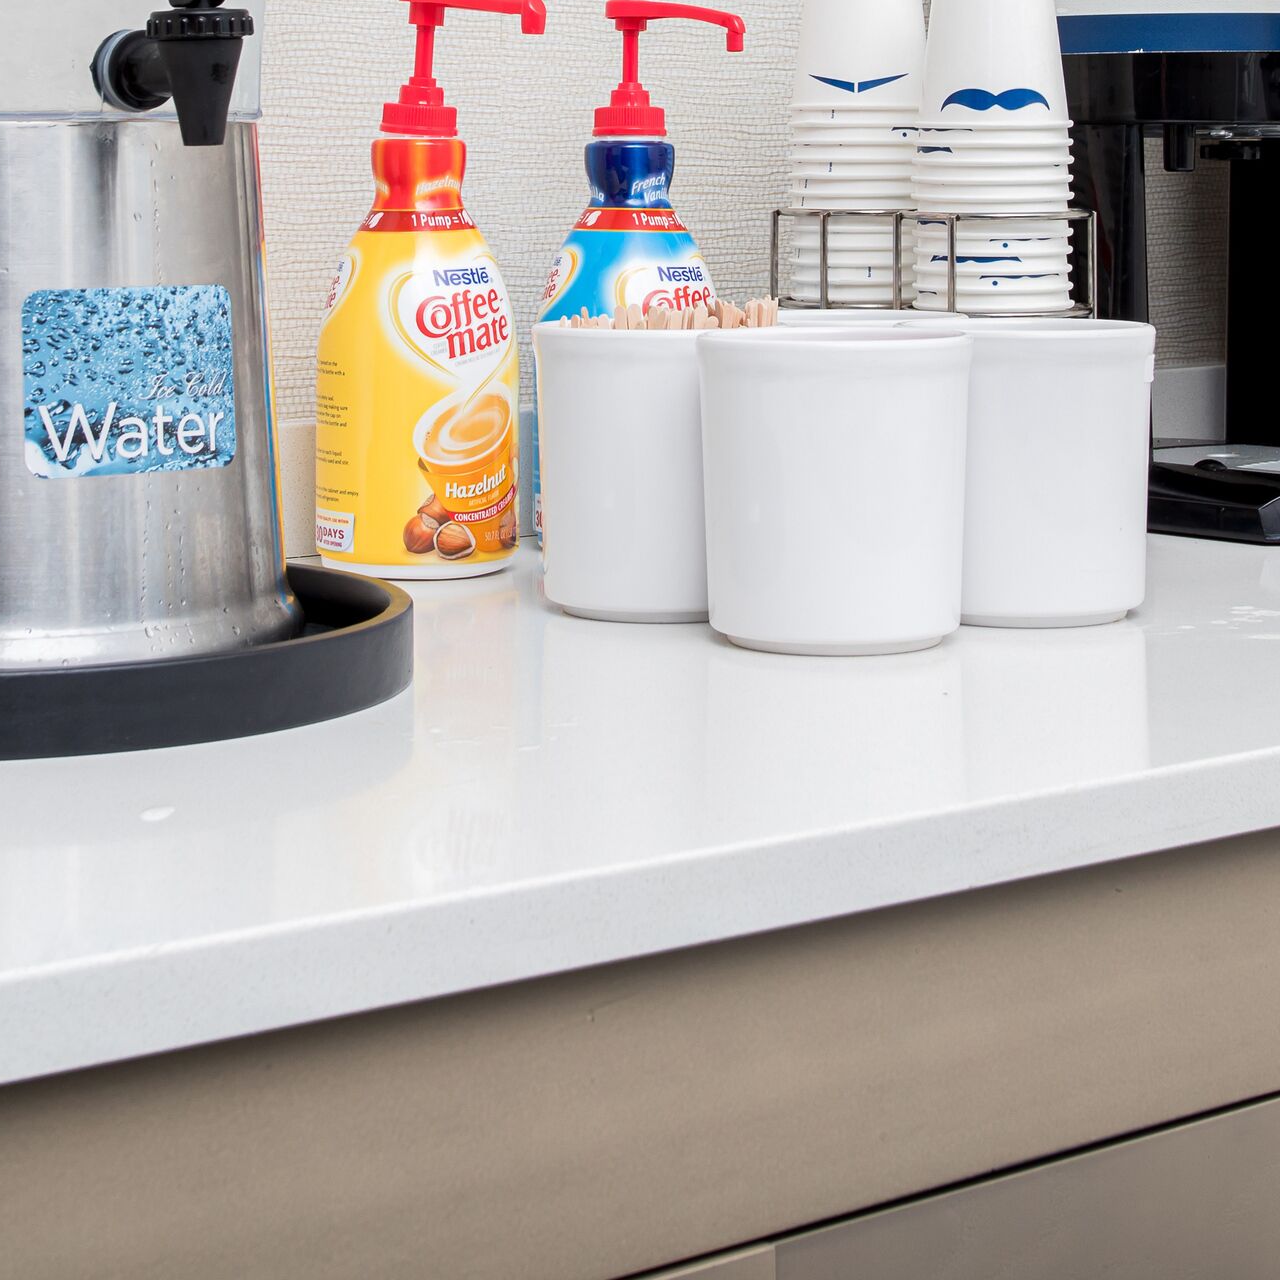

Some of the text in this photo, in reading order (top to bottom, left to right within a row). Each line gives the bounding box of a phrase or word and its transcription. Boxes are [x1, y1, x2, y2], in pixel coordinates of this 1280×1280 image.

[631, 172, 666, 196] French
[411, 214, 417, 227] 1
[632, 212, 639, 226] 1
[446, 315, 509, 359] mate
[139, 371, 228, 400] Ice Cold
[38, 401, 225, 462] Water
[445, 463, 506, 498] Hazelnut
[454, 506, 497, 521] CONCENTRATED
[323, 526, 344, 540] DAYS
